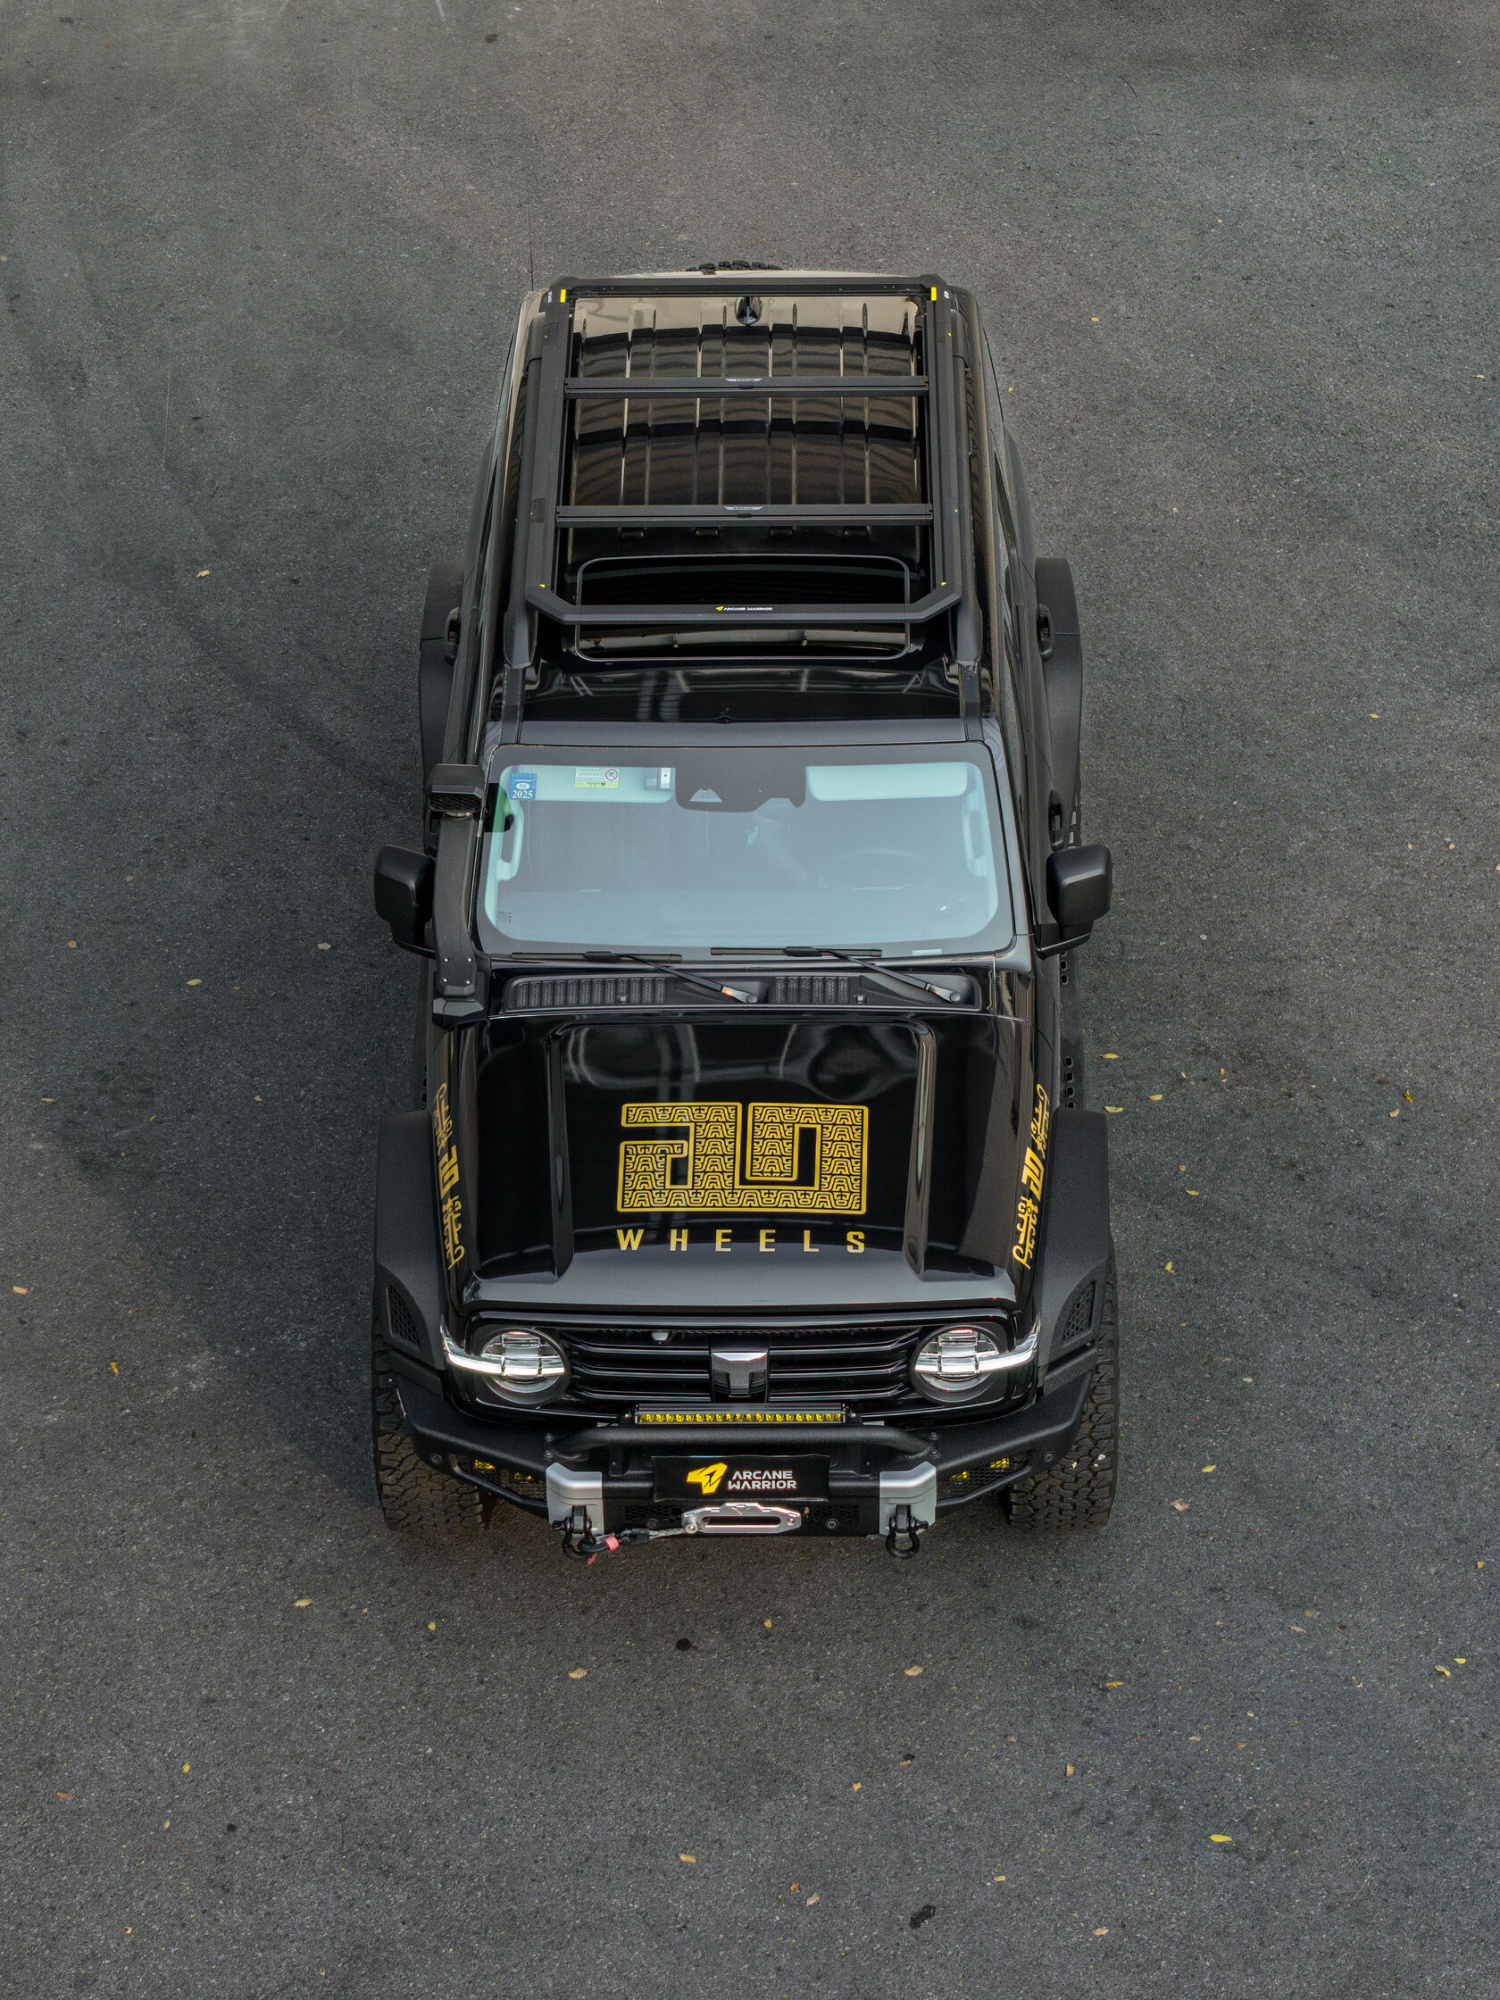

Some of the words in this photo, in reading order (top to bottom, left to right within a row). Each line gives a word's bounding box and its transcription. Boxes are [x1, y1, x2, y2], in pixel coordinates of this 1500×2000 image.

[511, 789, 533, 799] 2025
[616, 1228, 866, 1254] WHEELS
[732, 1470, 793, 1480] ARCANE
[728, 1480, 797, 1490] WARRIOR
